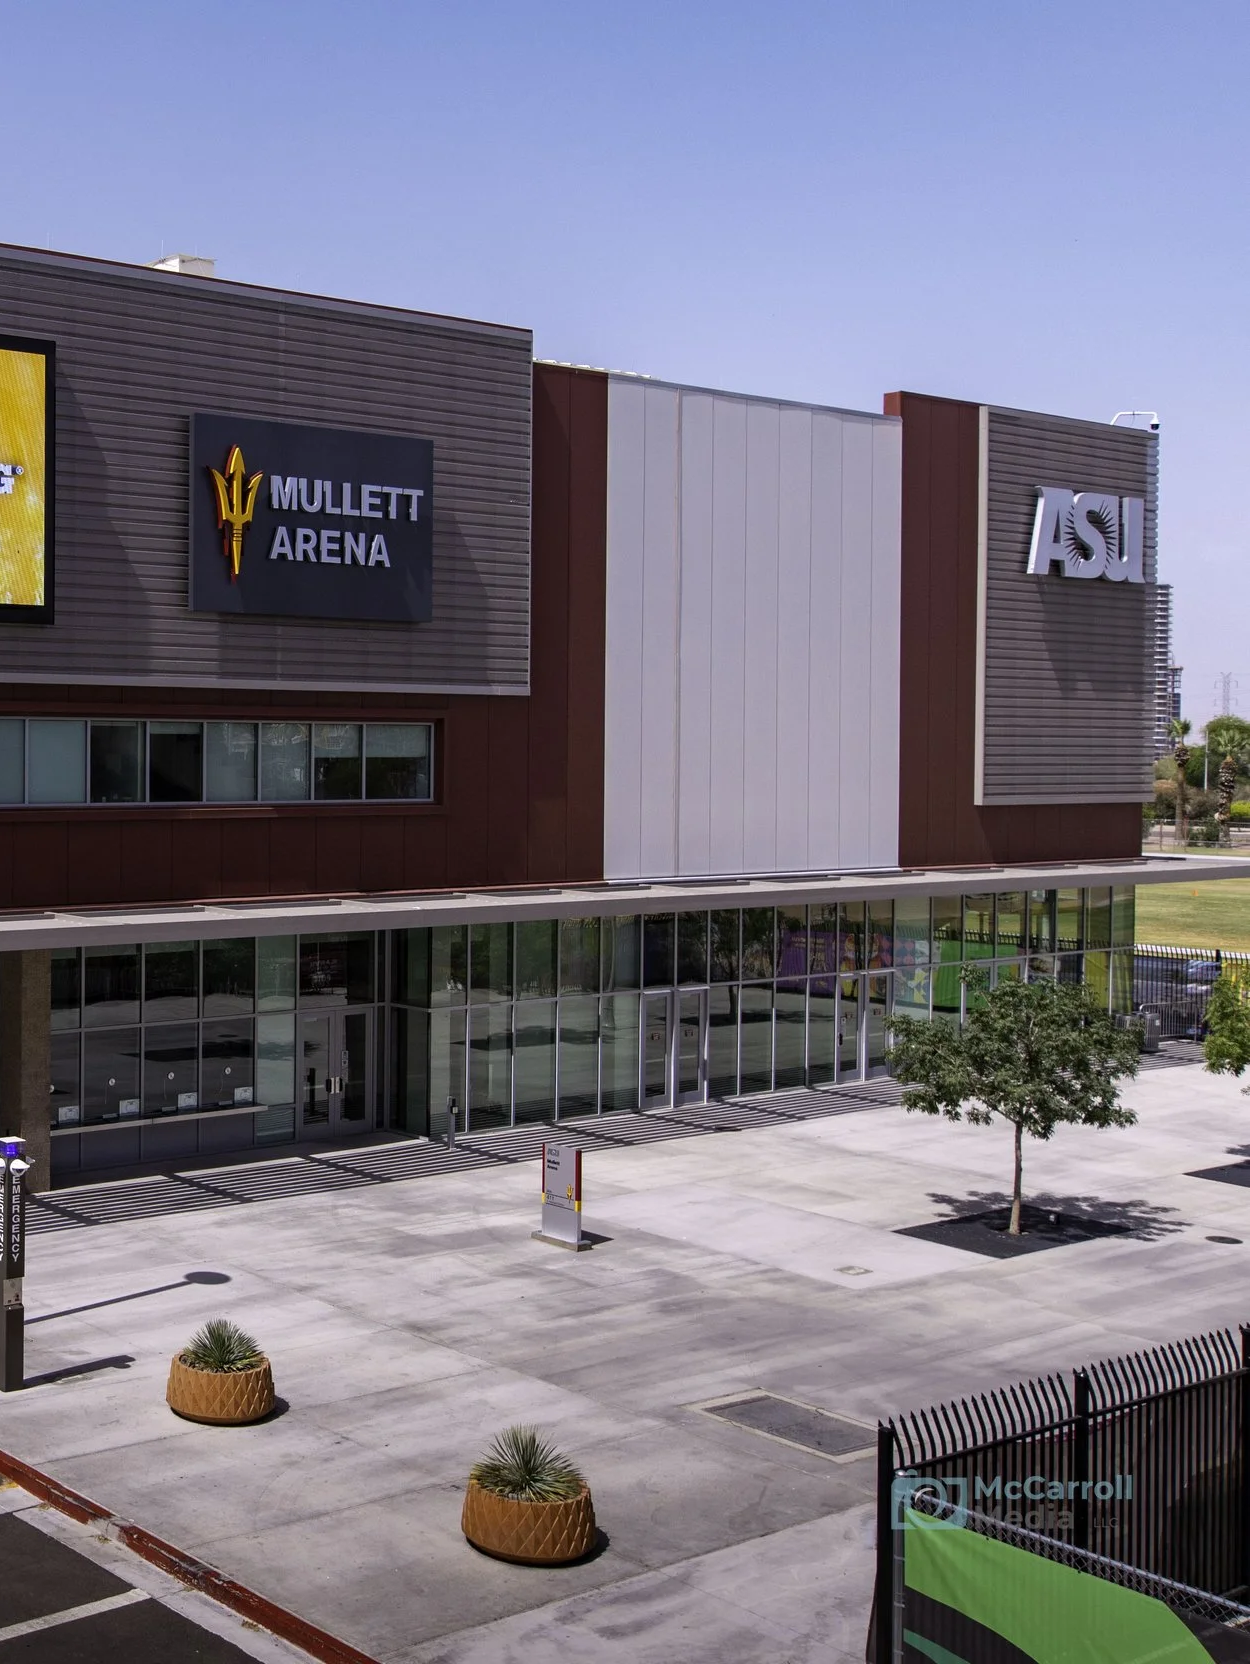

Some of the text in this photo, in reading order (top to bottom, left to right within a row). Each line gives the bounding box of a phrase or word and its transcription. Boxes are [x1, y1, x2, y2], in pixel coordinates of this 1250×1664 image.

[270, 475, 424, 521] MULLETT
[269, 526, 391, 567] ARENA
[1027, 486, 1146, 583] ASU
[12, 1175, 21, 1262] EMERGENCY
